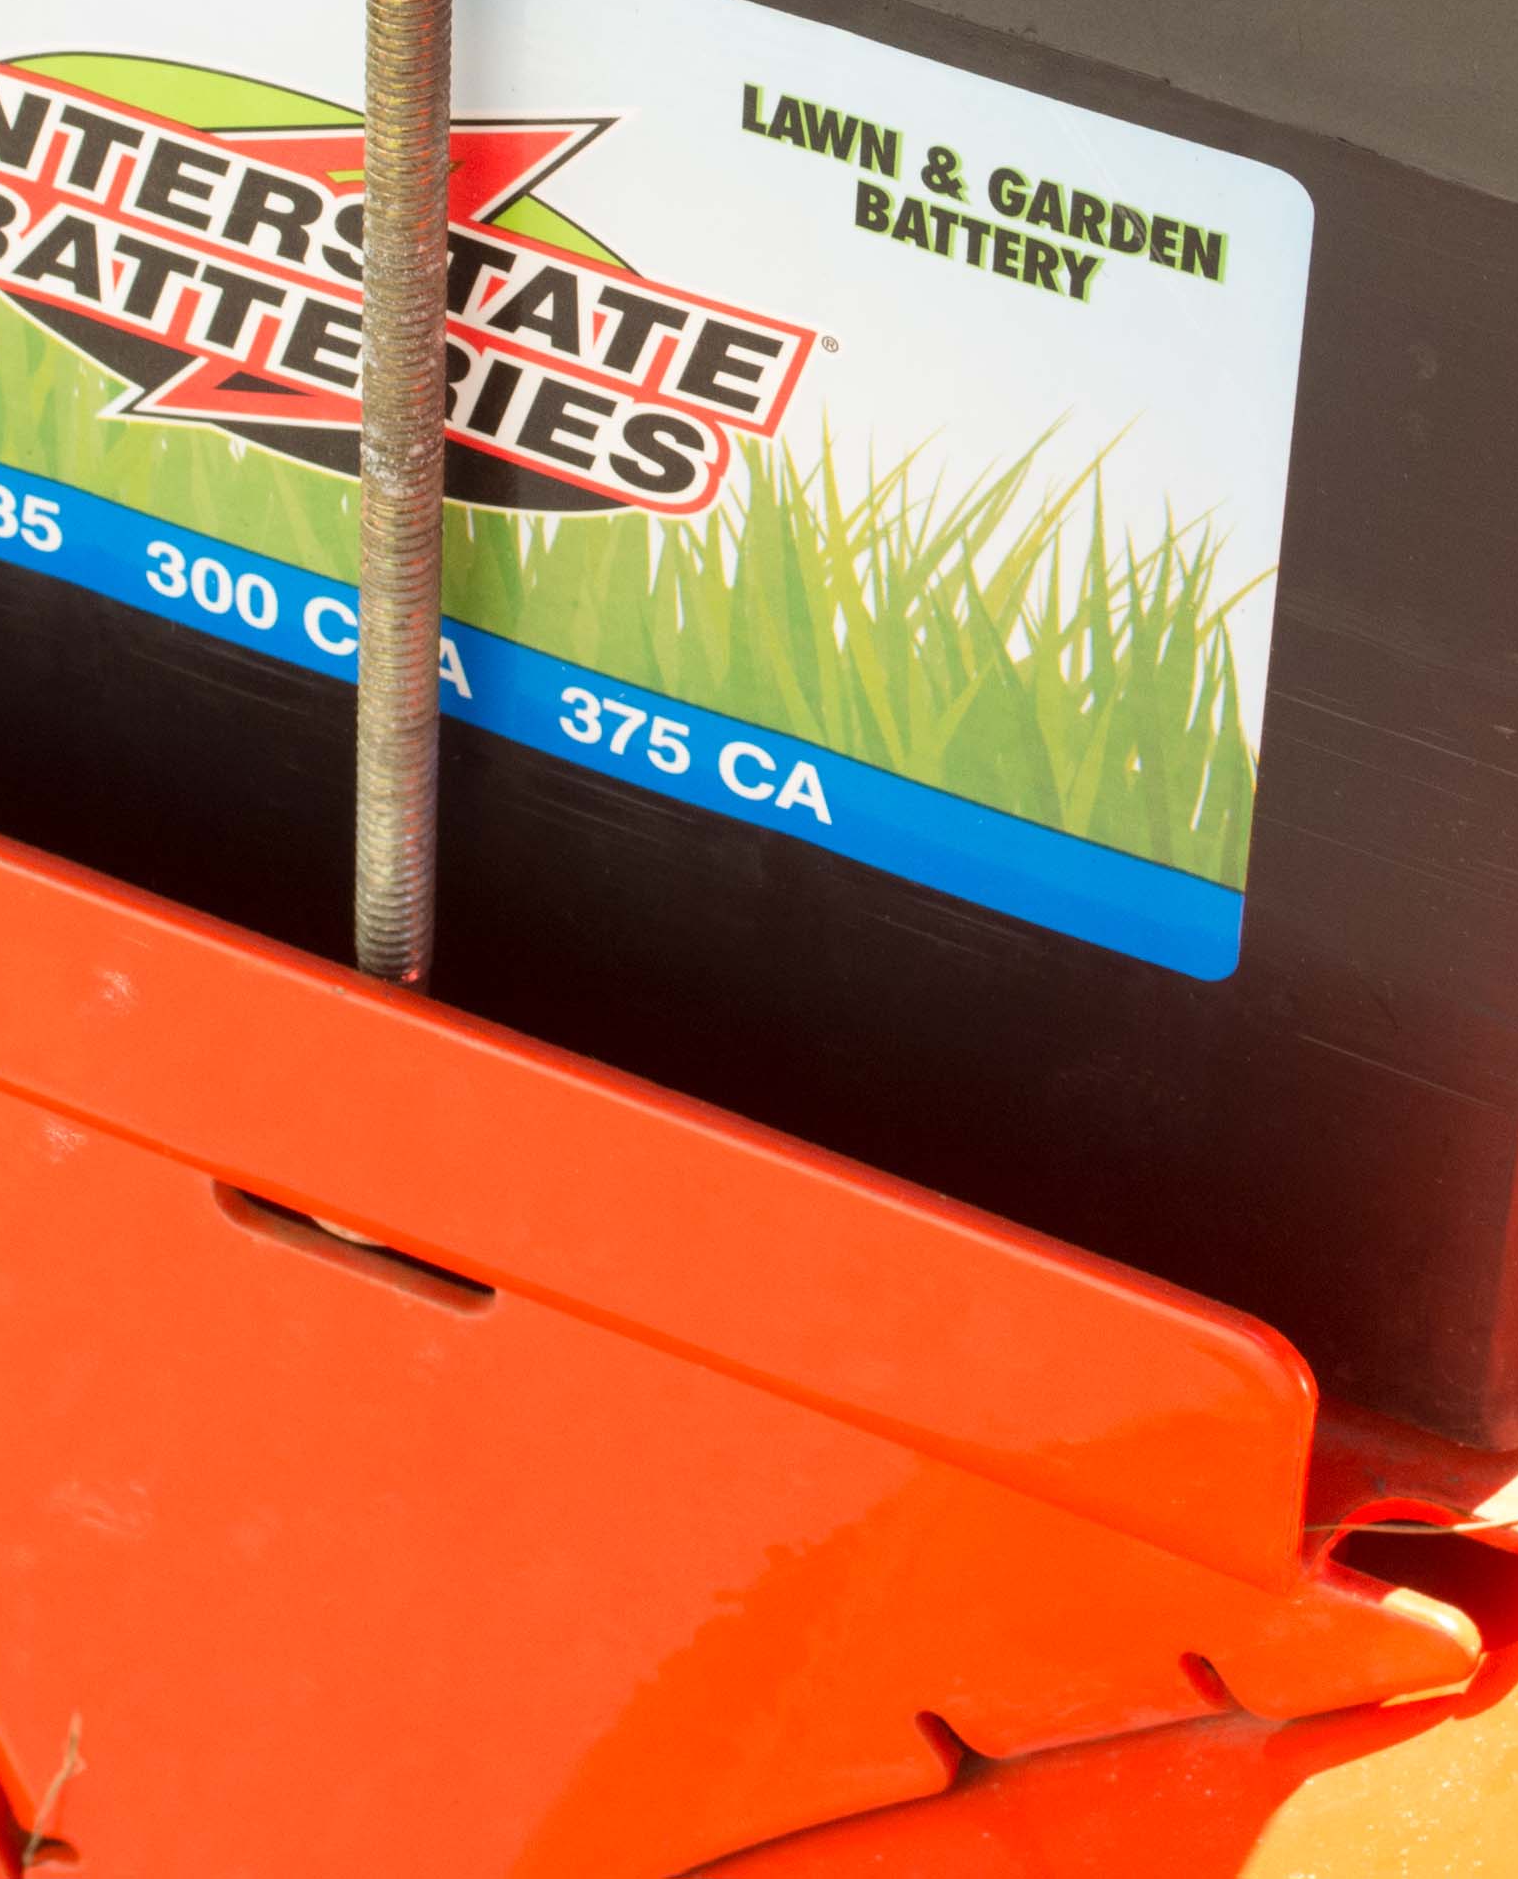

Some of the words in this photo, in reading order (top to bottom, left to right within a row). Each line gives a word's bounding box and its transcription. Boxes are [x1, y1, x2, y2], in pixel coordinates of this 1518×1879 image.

[741, 82, 902, 179] LAWN
[920, 145, 969, 204] &
[988, 167, 1230, 284] GARDEN
[855, 180, 1104, 304] BATTERY
[145, 541, 278, 631] 300
[303, 596, 472, 700] CA
[558, 687, 691, 776] 375
[718, 741, 833, 826] CA
